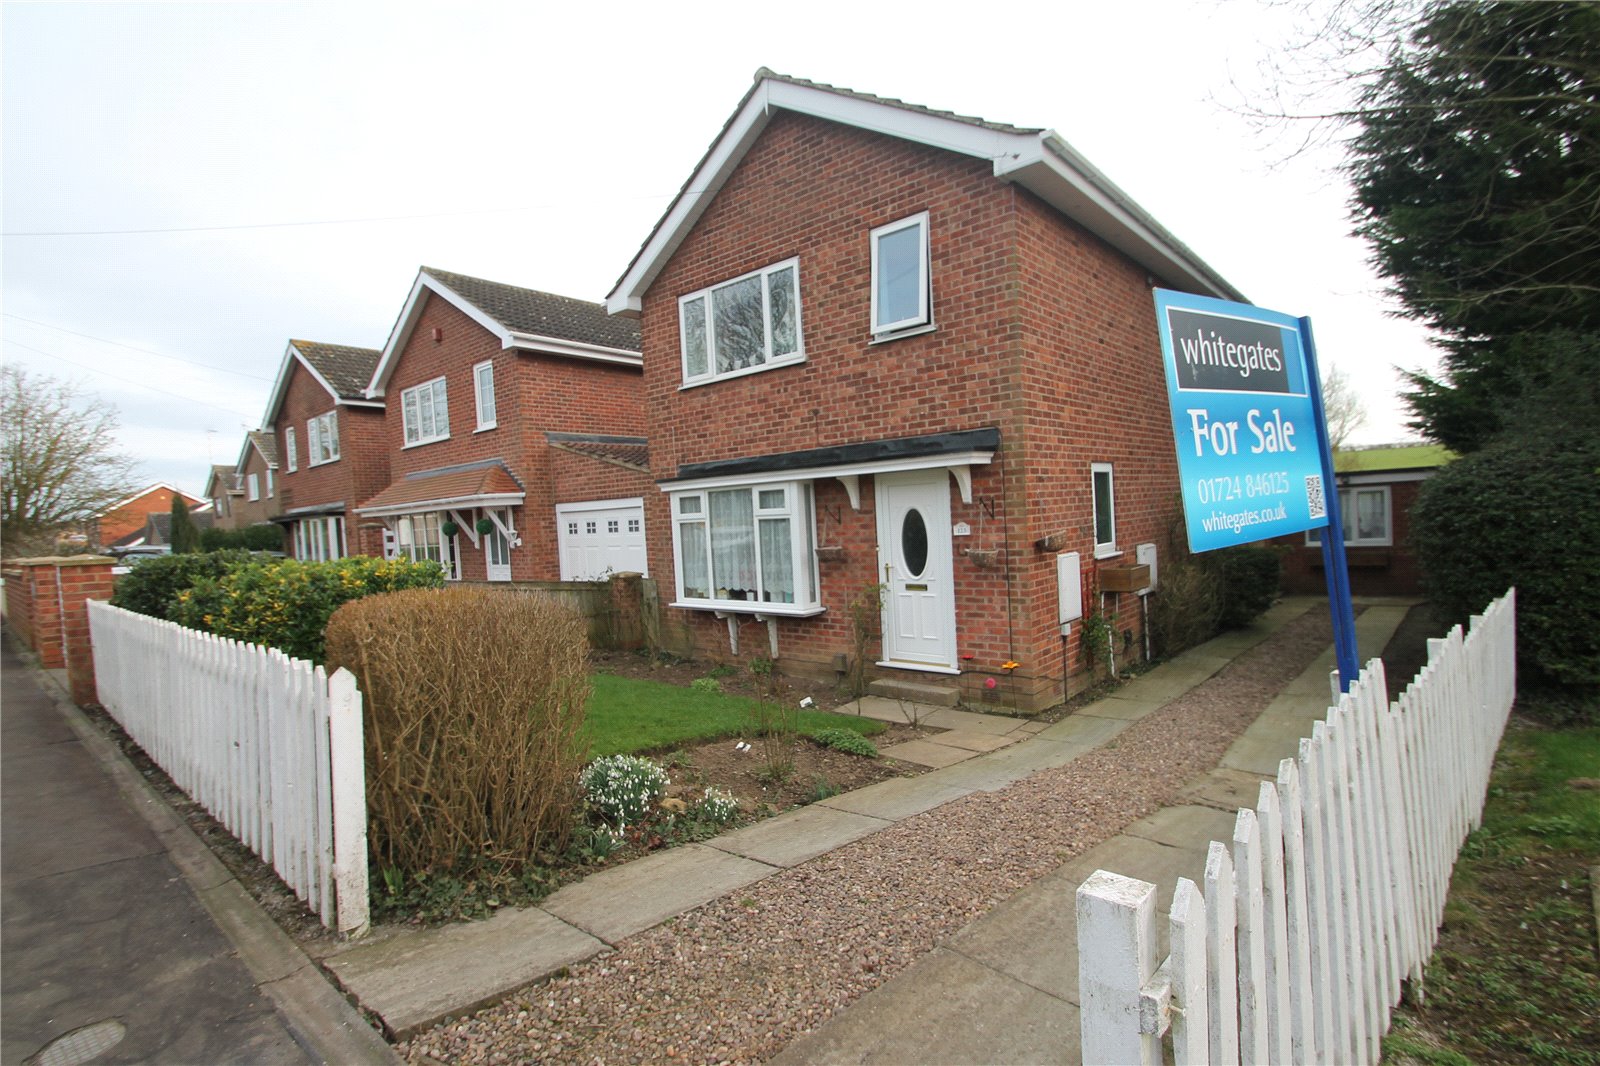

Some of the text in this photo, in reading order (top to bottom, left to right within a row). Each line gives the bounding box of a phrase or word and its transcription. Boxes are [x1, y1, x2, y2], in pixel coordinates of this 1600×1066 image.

[1180, 328, 1282, 377] whitegates
[1187, 408, 1296, 456] For Sale
[1198, 471, 1289, 504] 01724 846125
[1202, 502, 1287, 533] whitegates.co.uk
